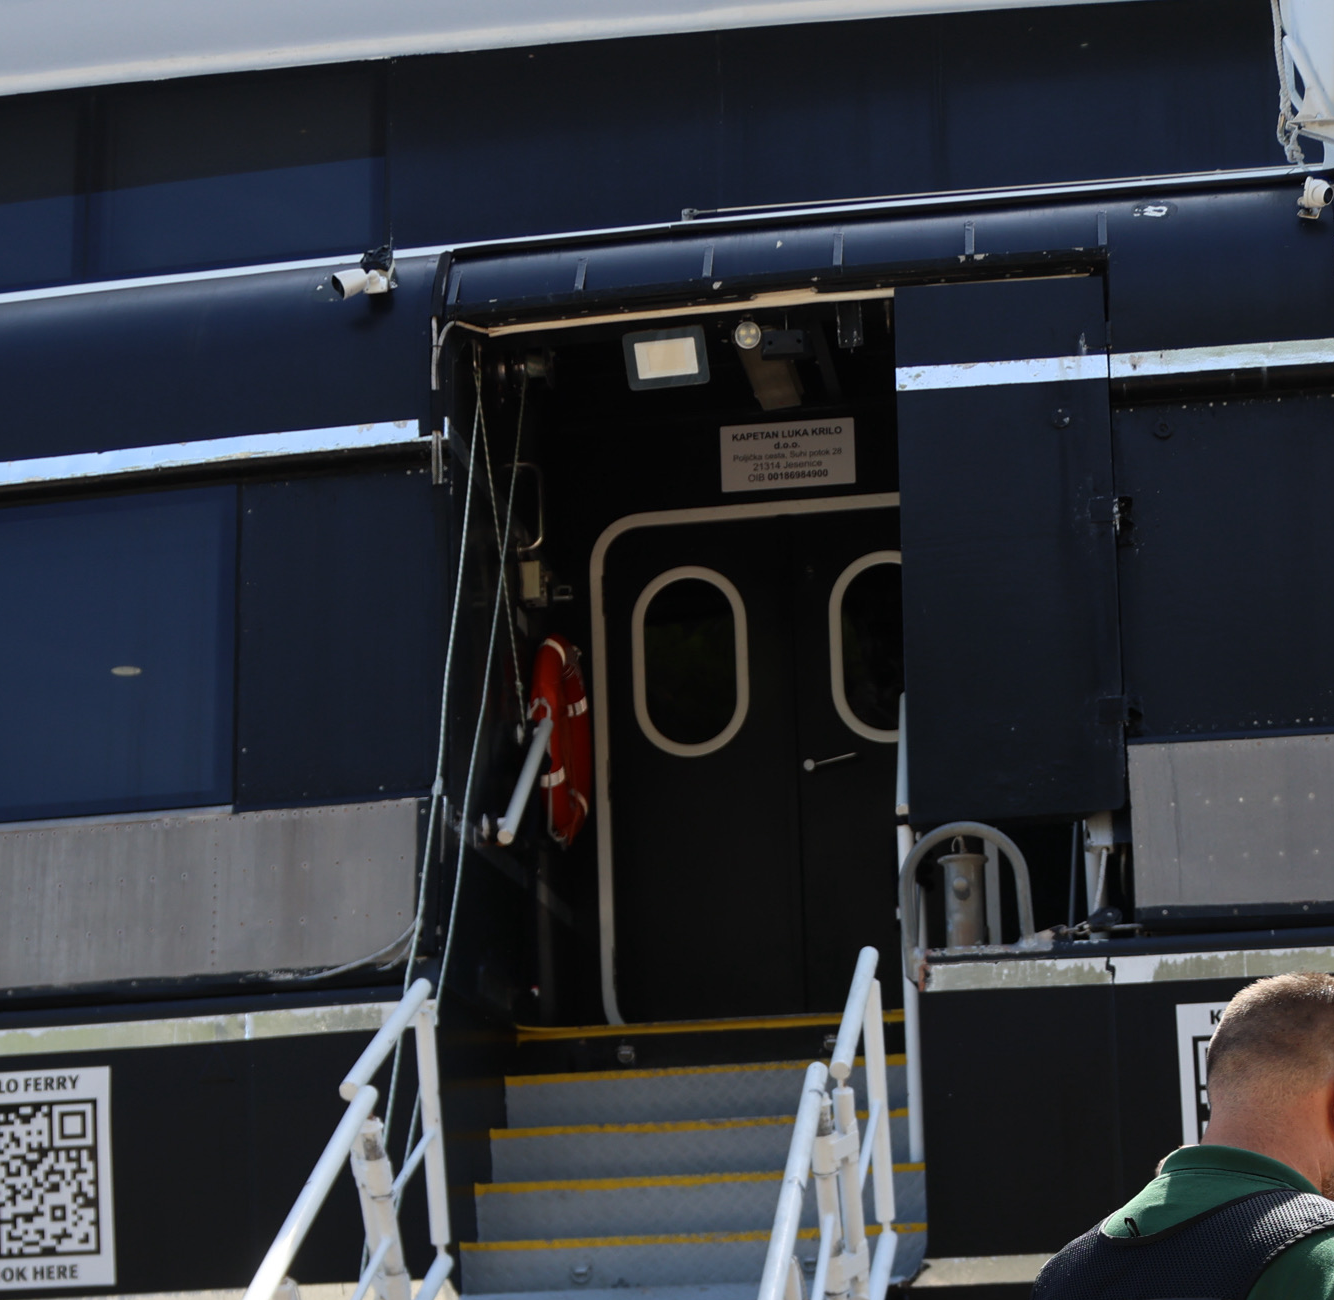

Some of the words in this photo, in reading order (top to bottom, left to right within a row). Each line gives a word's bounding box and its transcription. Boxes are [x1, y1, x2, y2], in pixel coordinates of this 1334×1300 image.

[732, 431, 779, 442] KAPETAN
[782, 428, 809, 438] LUKA
[811, 426, 842, 436] KRILO
[774, 441, 800, 450] d.o.o.
[832, 447, 842, 455] 28
[753, 462, 781, 471] 21314
[783, 460, 823, 469] Jesenice
[748, 474, 765, 482] OIB
[24, 1074, 80, 1092] FERRY
[33, 1264, 78, 1280] HERE
